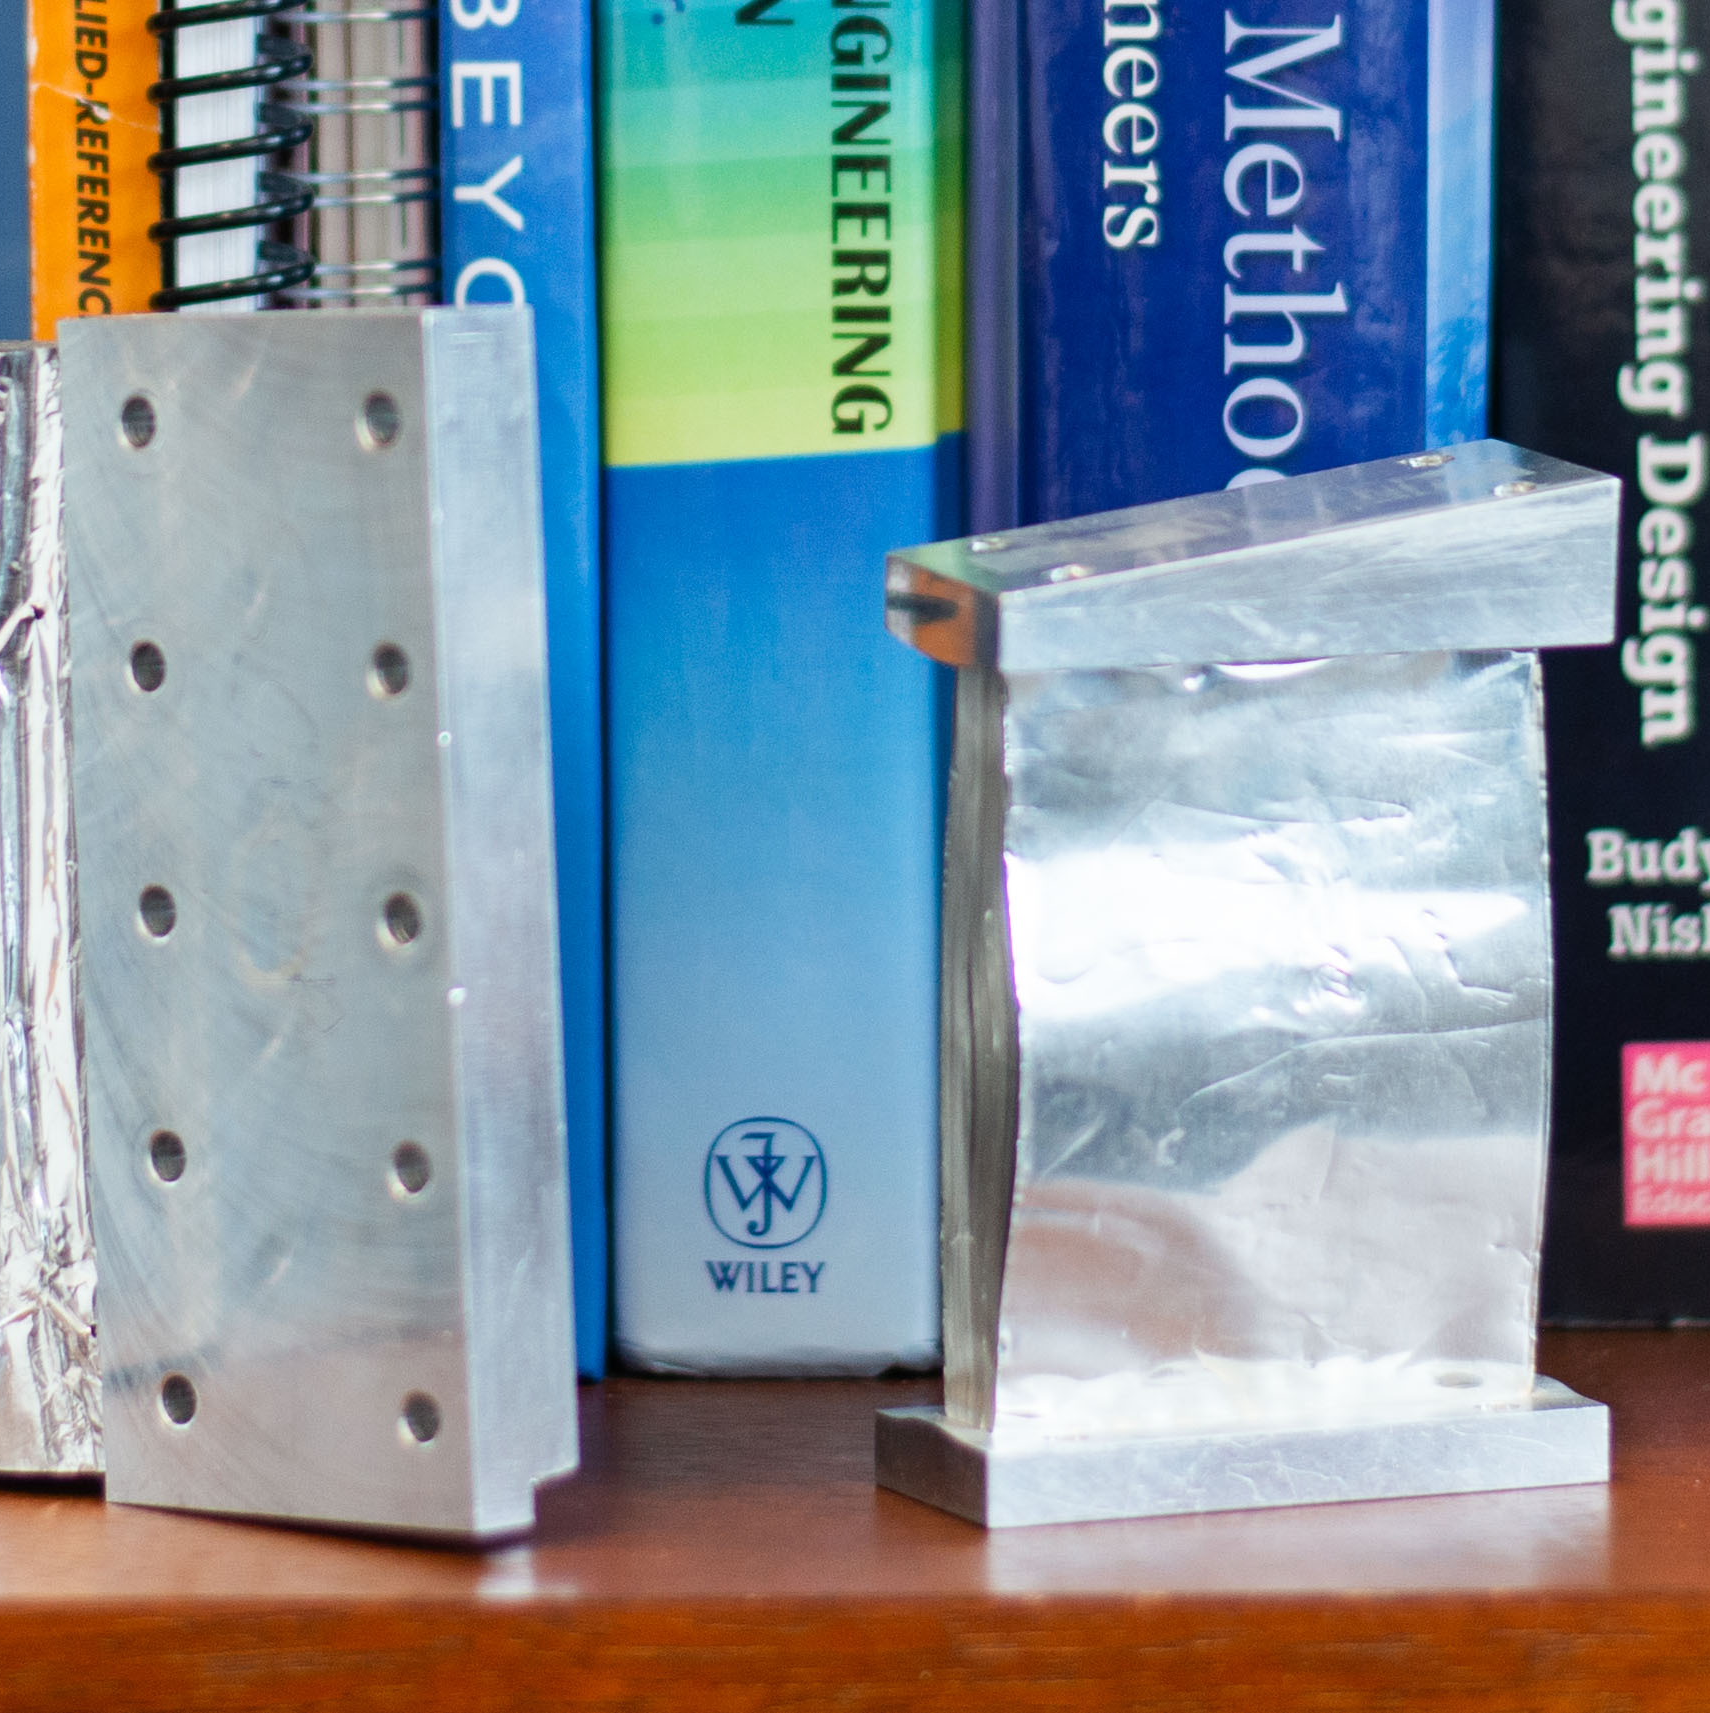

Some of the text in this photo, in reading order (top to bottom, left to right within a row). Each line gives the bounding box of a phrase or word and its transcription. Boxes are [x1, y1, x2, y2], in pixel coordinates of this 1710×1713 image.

[1222, 14, 1350, 488] Metho
[1620, 434, 1710, 749] Design
[1633, 1053, 1706, 1094] Mc
[1632, 1141, 1710, 1183] Hill
[705, 1261, 825, 1293] WILEY
